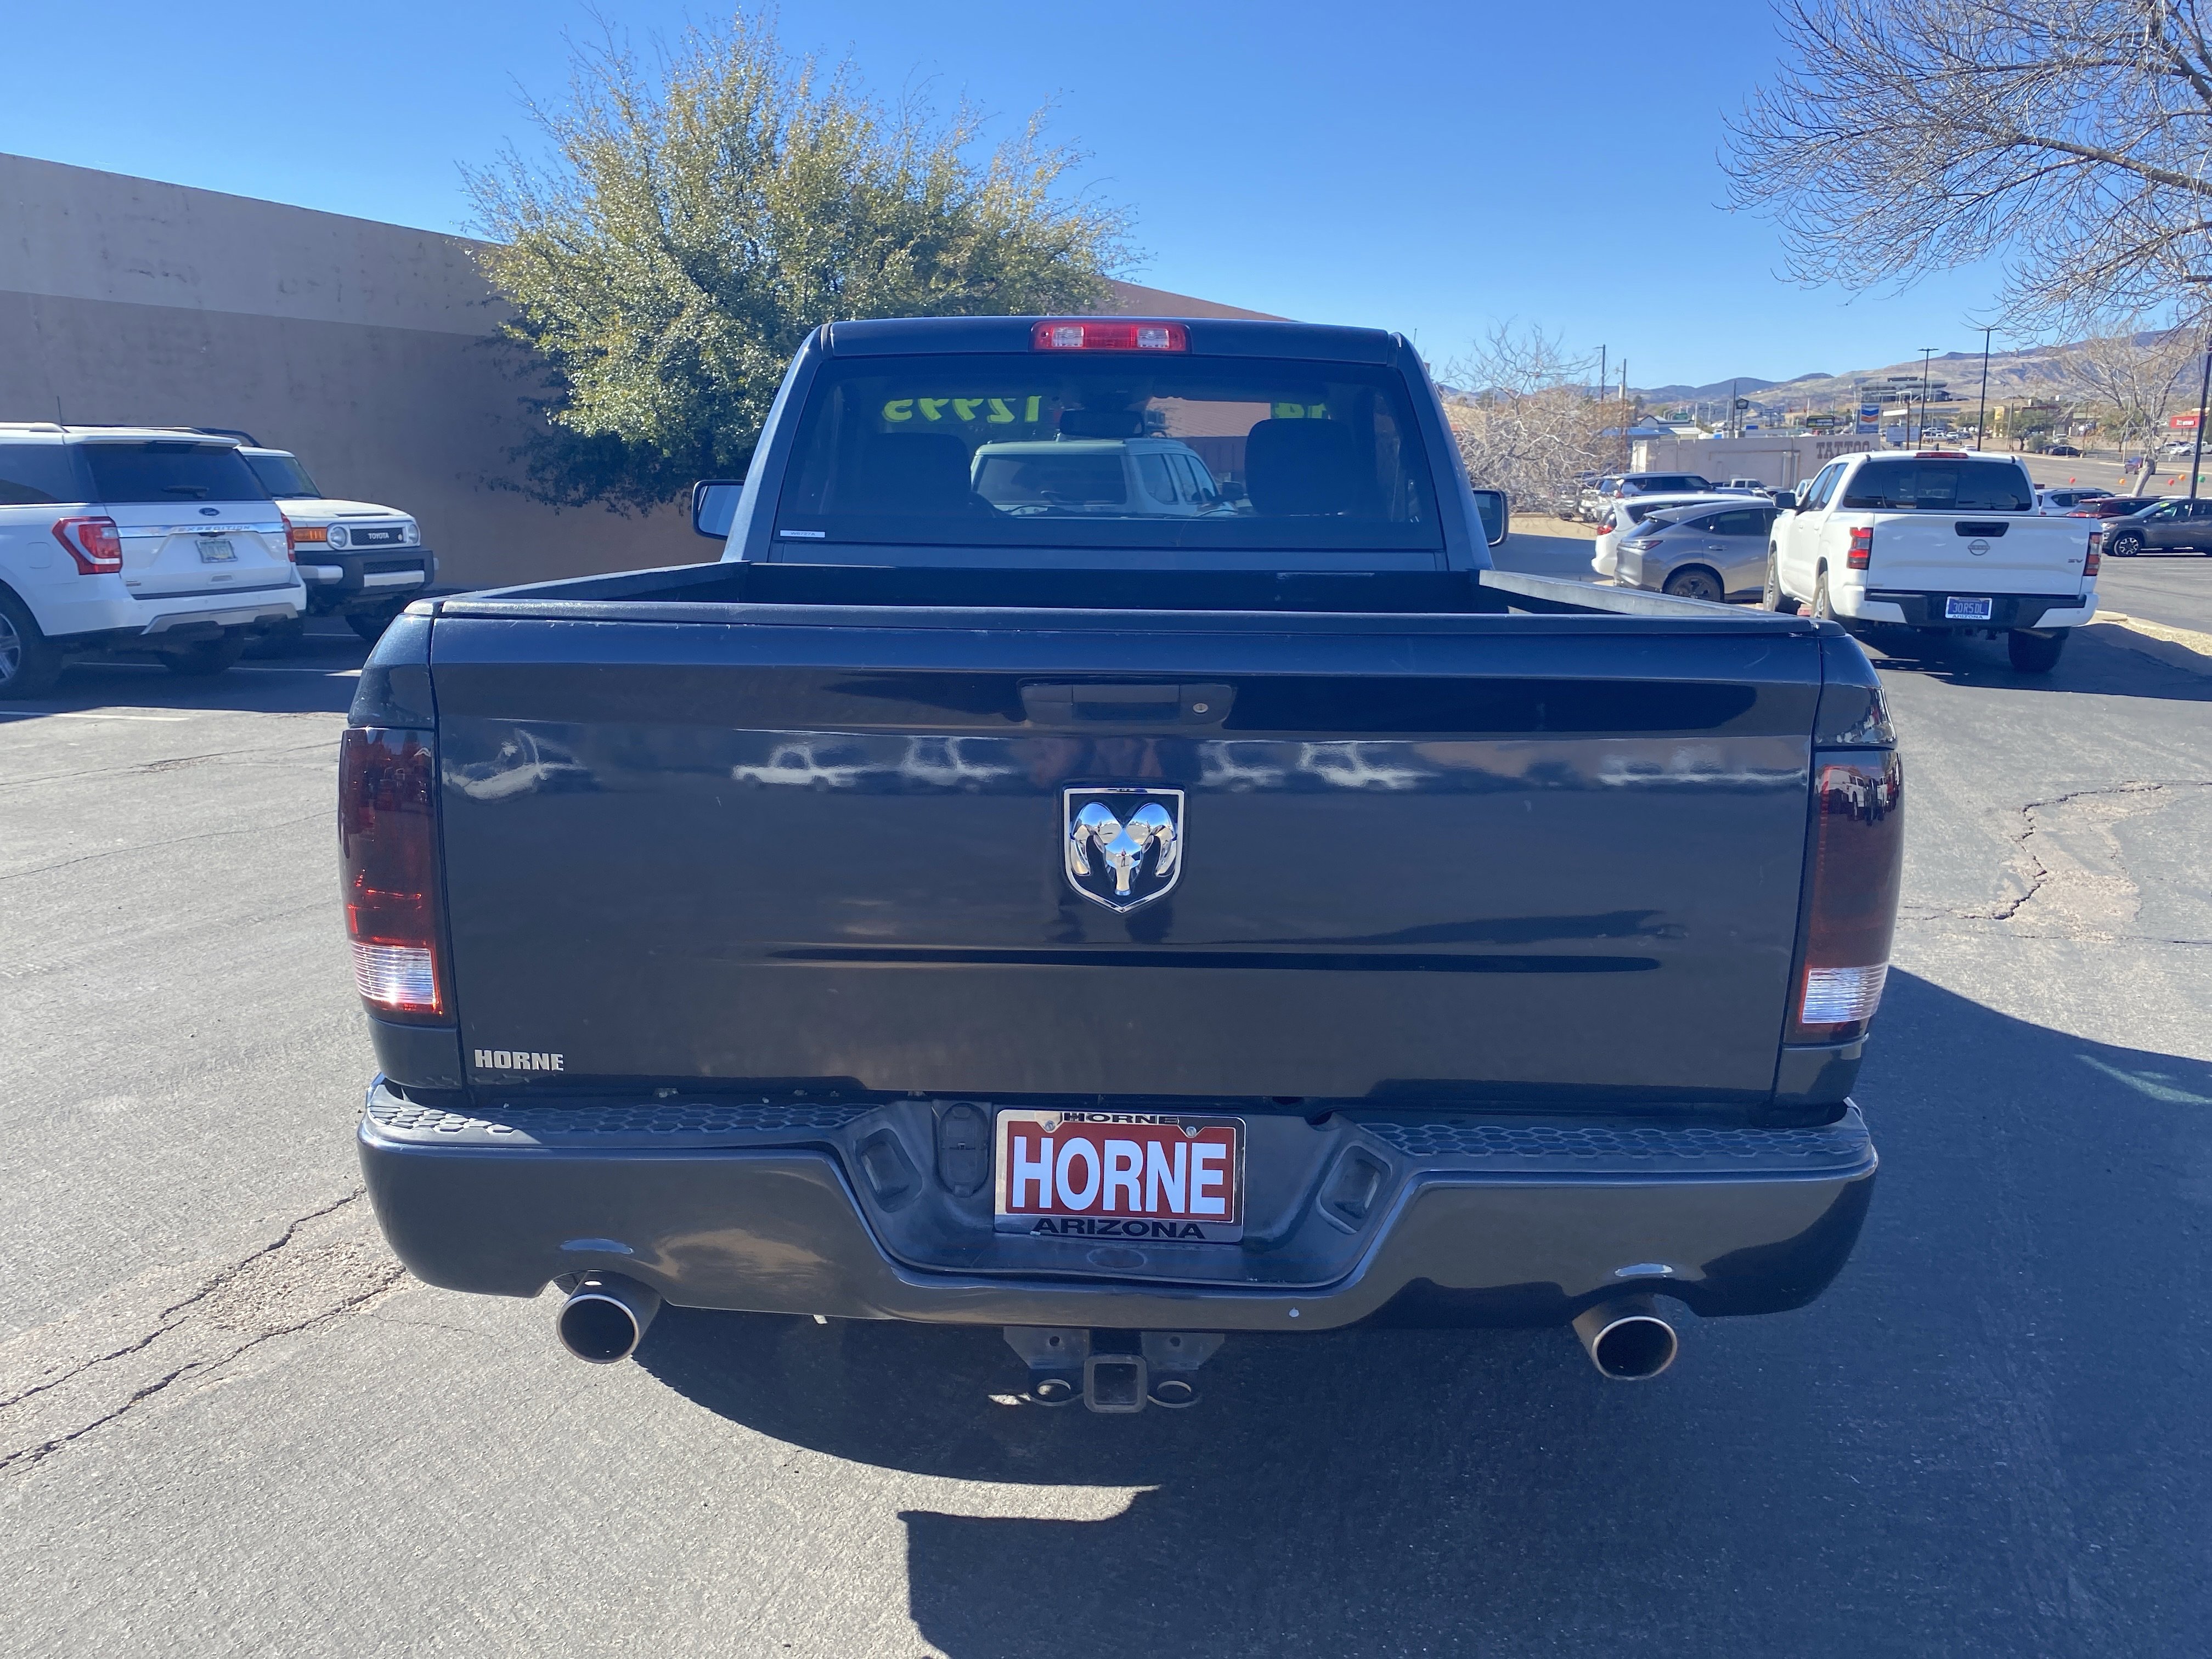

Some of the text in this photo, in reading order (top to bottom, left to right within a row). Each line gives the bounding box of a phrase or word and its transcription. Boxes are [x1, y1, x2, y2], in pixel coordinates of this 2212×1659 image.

[1816, 441, 1870, 459] TATTOO
[474, 1049, 564, 1071] HORNE
[1064, 1112, 1180, 1125] HORNE
[1012, 1136, 1227, 1215] HORNE
[1032, 1217, 1206, 1239] ARIZONA
